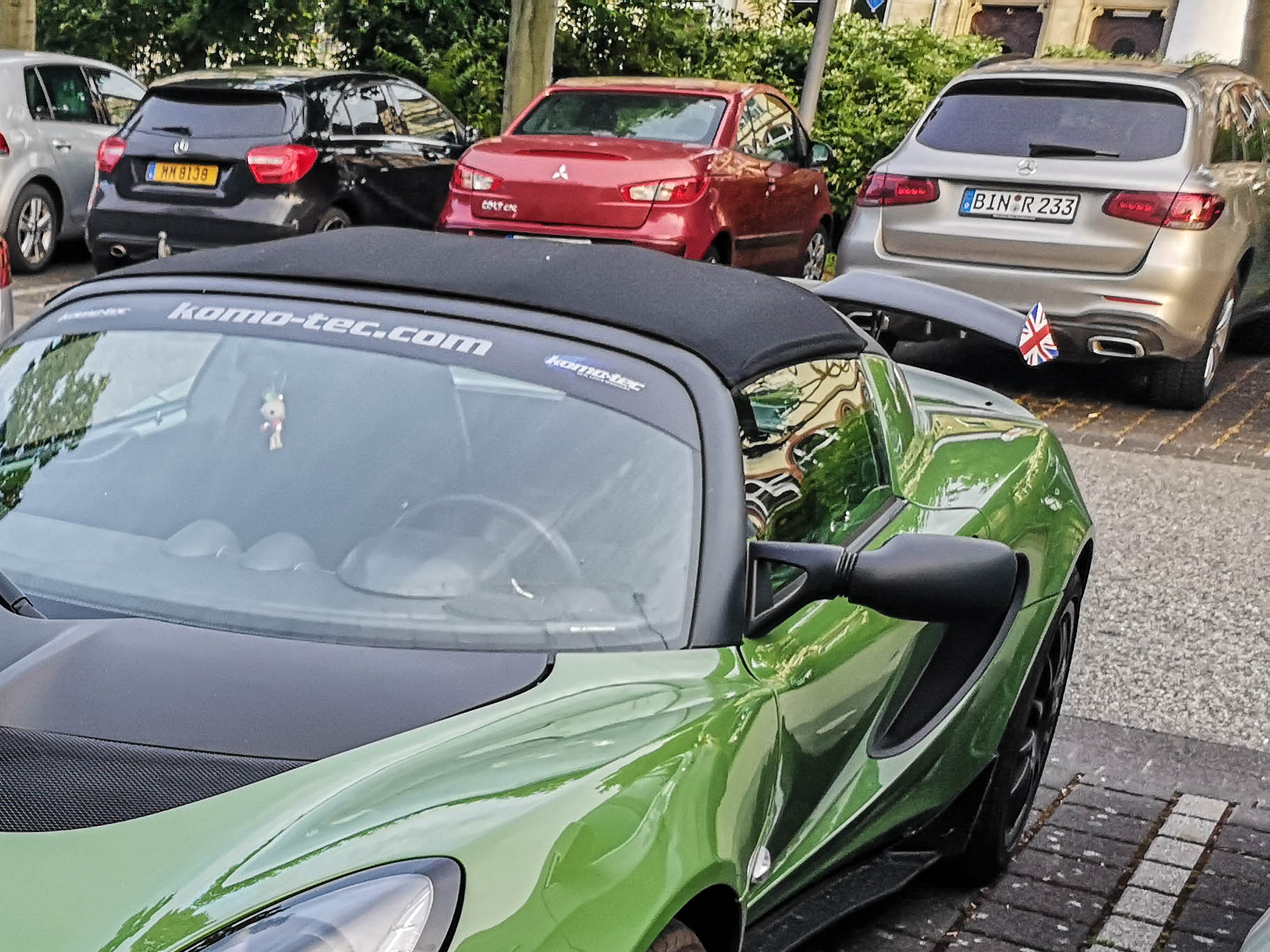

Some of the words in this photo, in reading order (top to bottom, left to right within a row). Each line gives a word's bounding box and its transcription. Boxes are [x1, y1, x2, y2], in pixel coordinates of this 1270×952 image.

[973, 193, 1011, 211] BIN
[1021, 196, 1034, 213] R
[1038, 198, 1075, 216] 233
[167, 301, 494, 357] komo-tec.com
